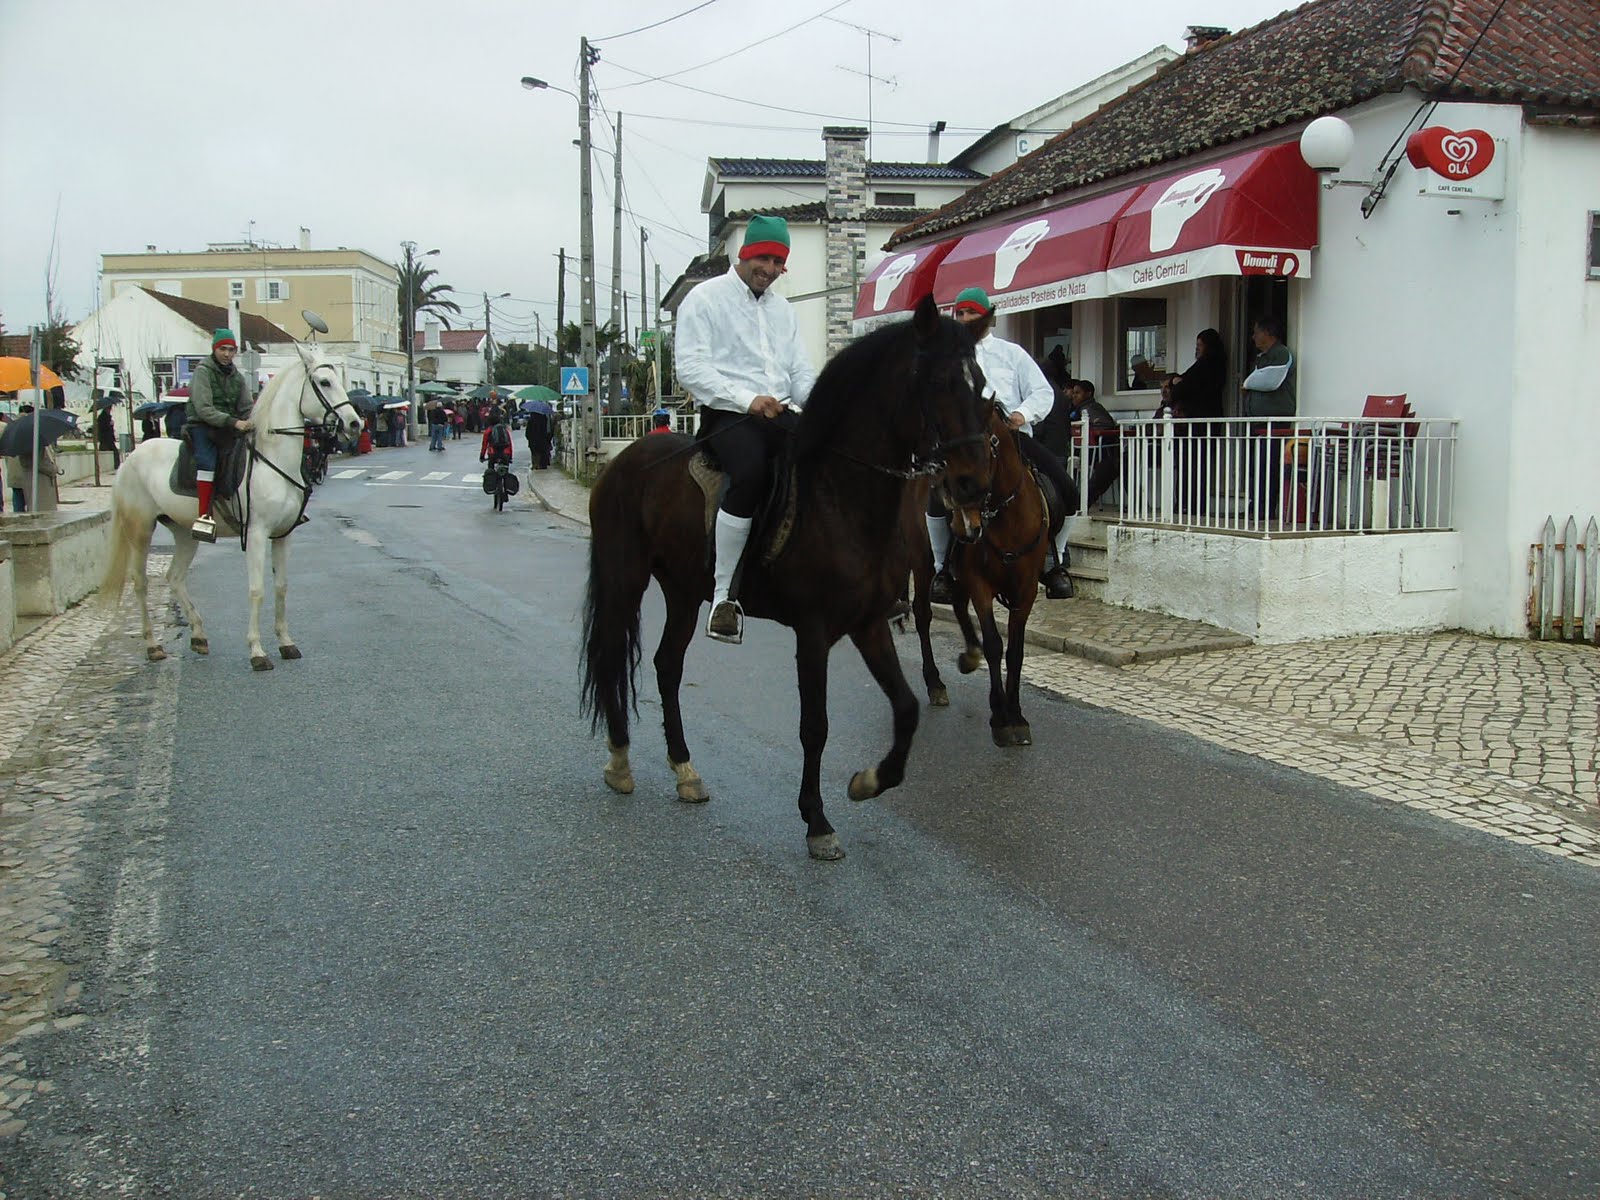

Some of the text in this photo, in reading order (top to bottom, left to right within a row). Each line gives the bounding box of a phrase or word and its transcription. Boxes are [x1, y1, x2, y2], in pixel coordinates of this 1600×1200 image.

[1448, 161, 1470, 175] OLÁ
[1243, 253, 1278, 268] Buondi
[1132, 260, 1189, 284] Café Central
[1057, 285, 1067, 298] de
[1068, 282, 1086, 296] Nata
